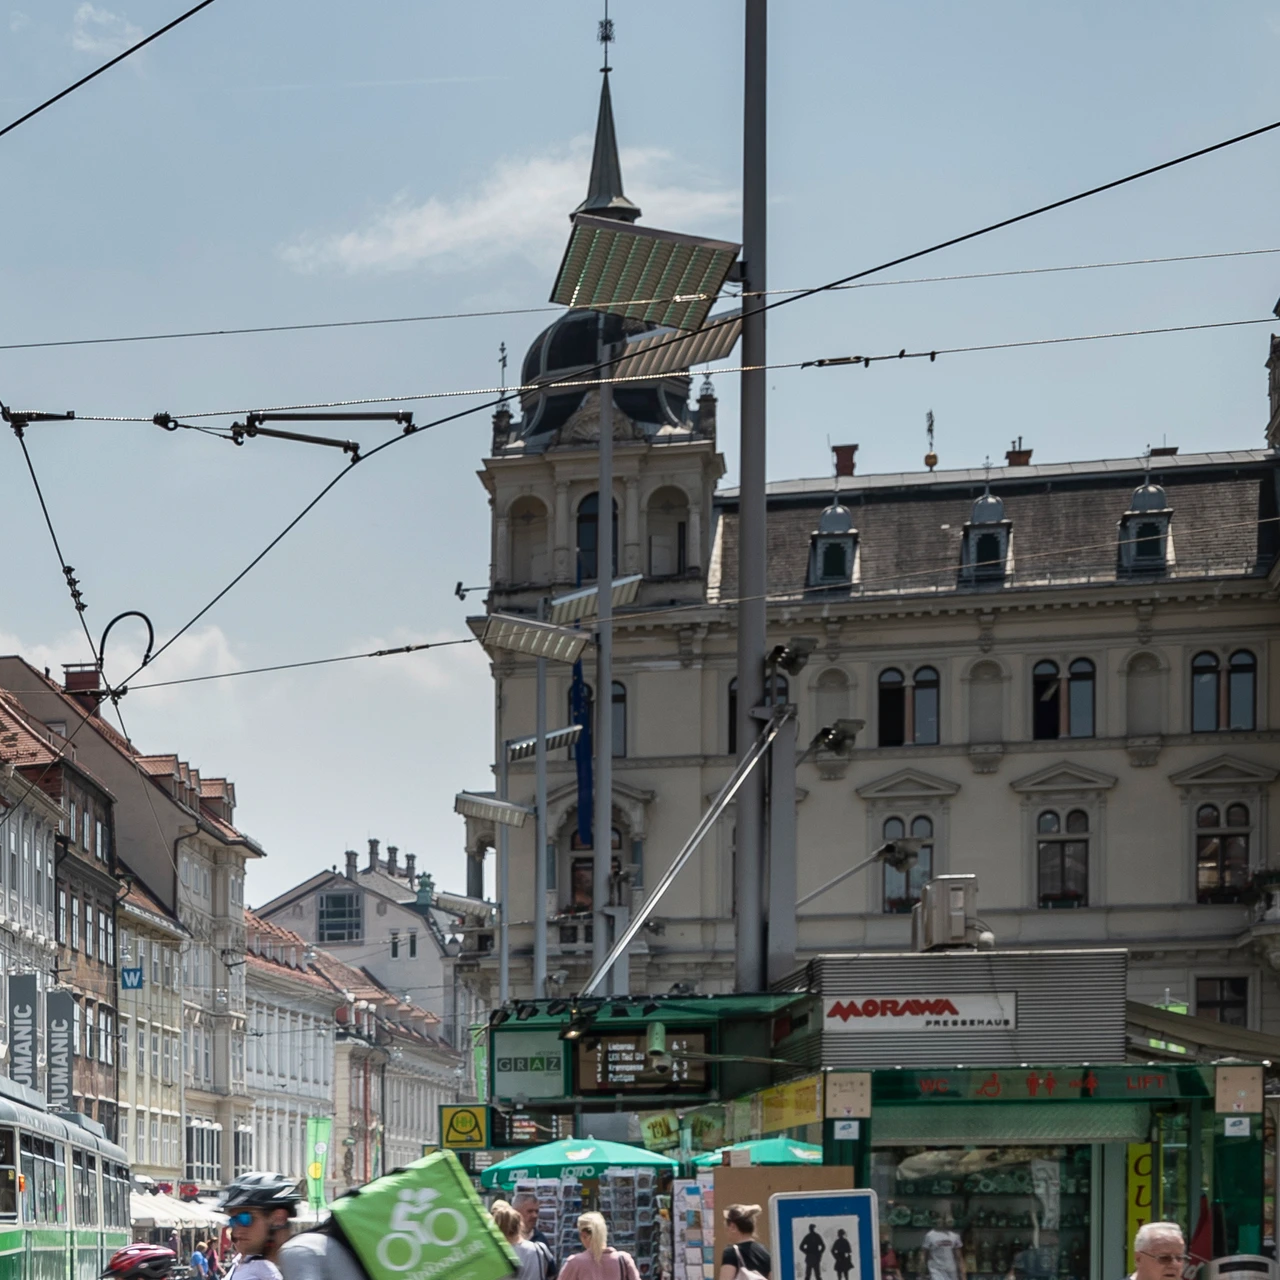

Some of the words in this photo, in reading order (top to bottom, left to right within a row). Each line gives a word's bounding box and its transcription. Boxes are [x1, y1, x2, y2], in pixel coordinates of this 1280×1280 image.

[123, 972, 140, 987] W
[827, 998, 959, 1022] MORAWA
[925, 1019, 1011, 1027] PRESSEHAUS
[14, 1004, 32, 1089] UMANIC
[498, 1058, 559, 1071] GRAZ
[920, 1078, 948, 1093] WC
[1127, 1075, 1166, 1090] LIFT
[560, 1166, 595, 1178] LOTTO
